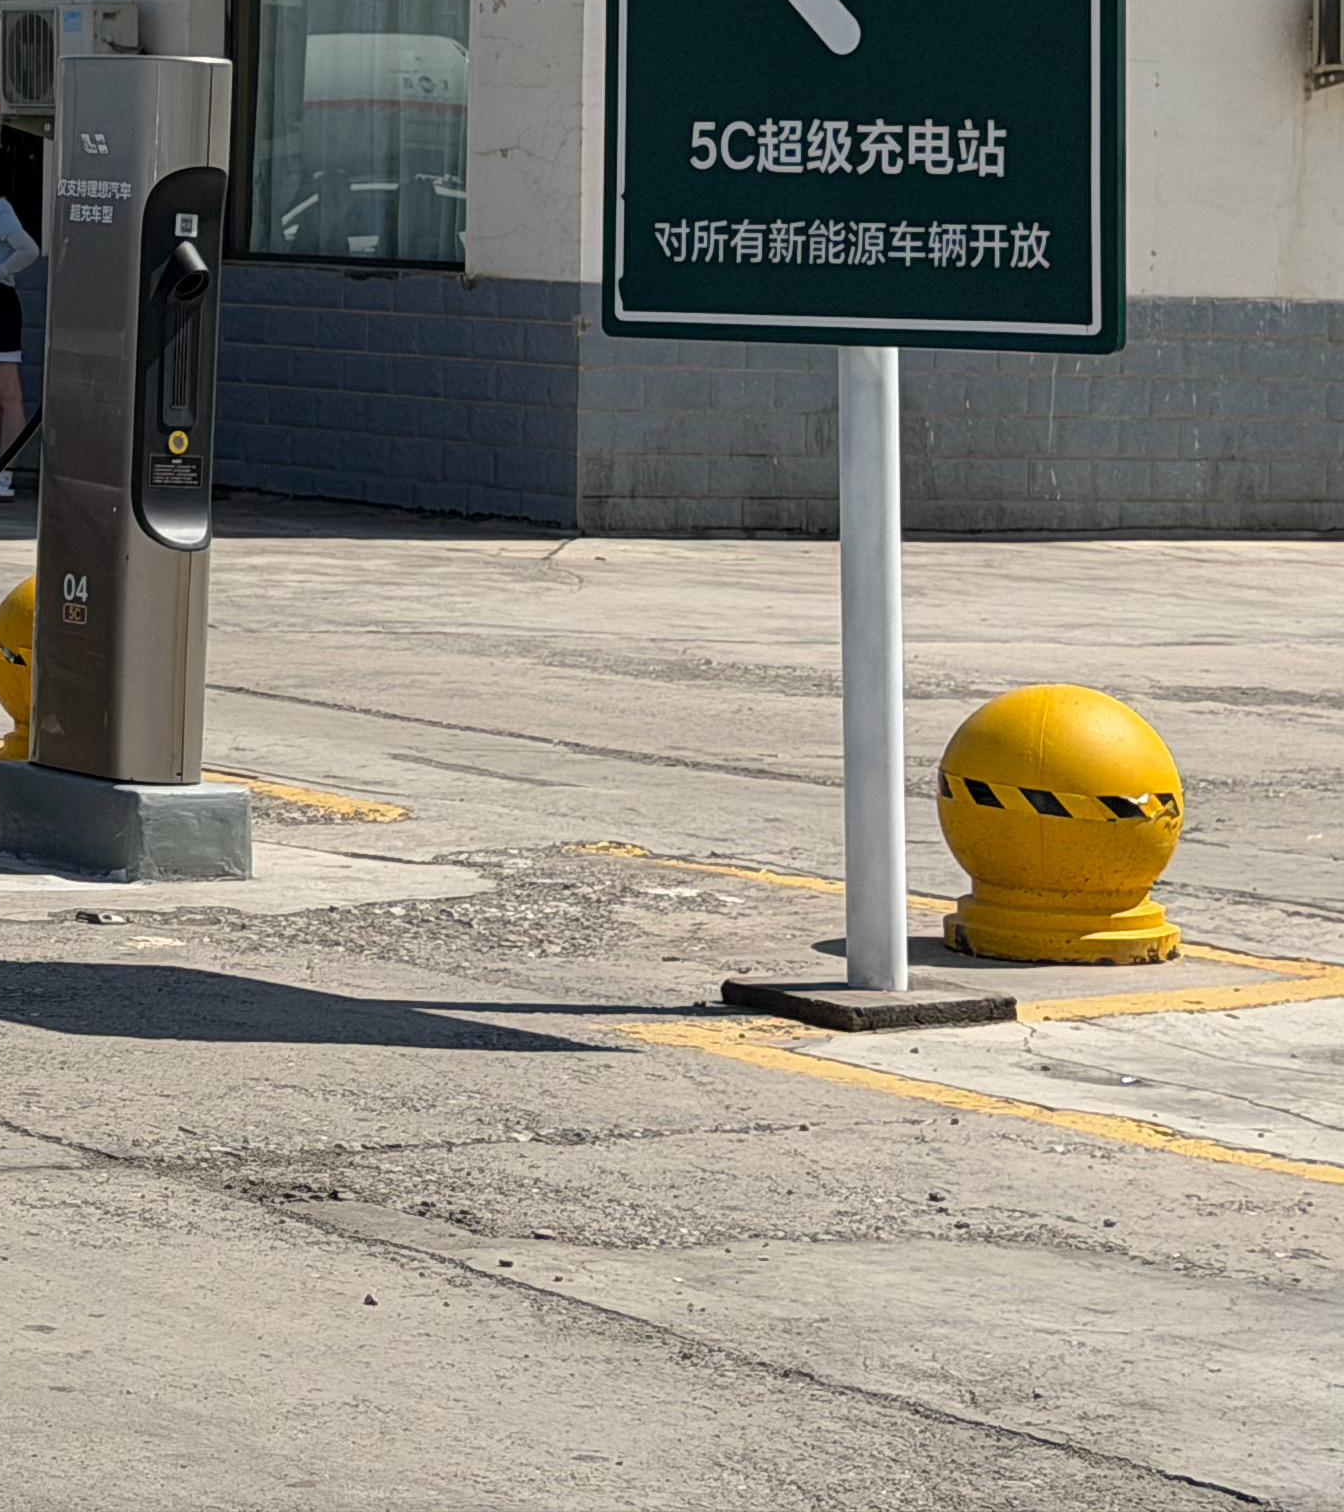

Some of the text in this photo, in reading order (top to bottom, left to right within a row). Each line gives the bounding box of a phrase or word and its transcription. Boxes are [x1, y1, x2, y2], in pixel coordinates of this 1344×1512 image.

[689, 117, 1007, 178] 5C超级充电站
[57, 179, 132, 200] 仅支持理想汽车
[69, 203, 114, 224] 超充车型
[654, 218, 1051, 270] 对所有新能源车辆开放
[63, 573, 89, 603] 04
[68, 605, 82, 621] 5C
